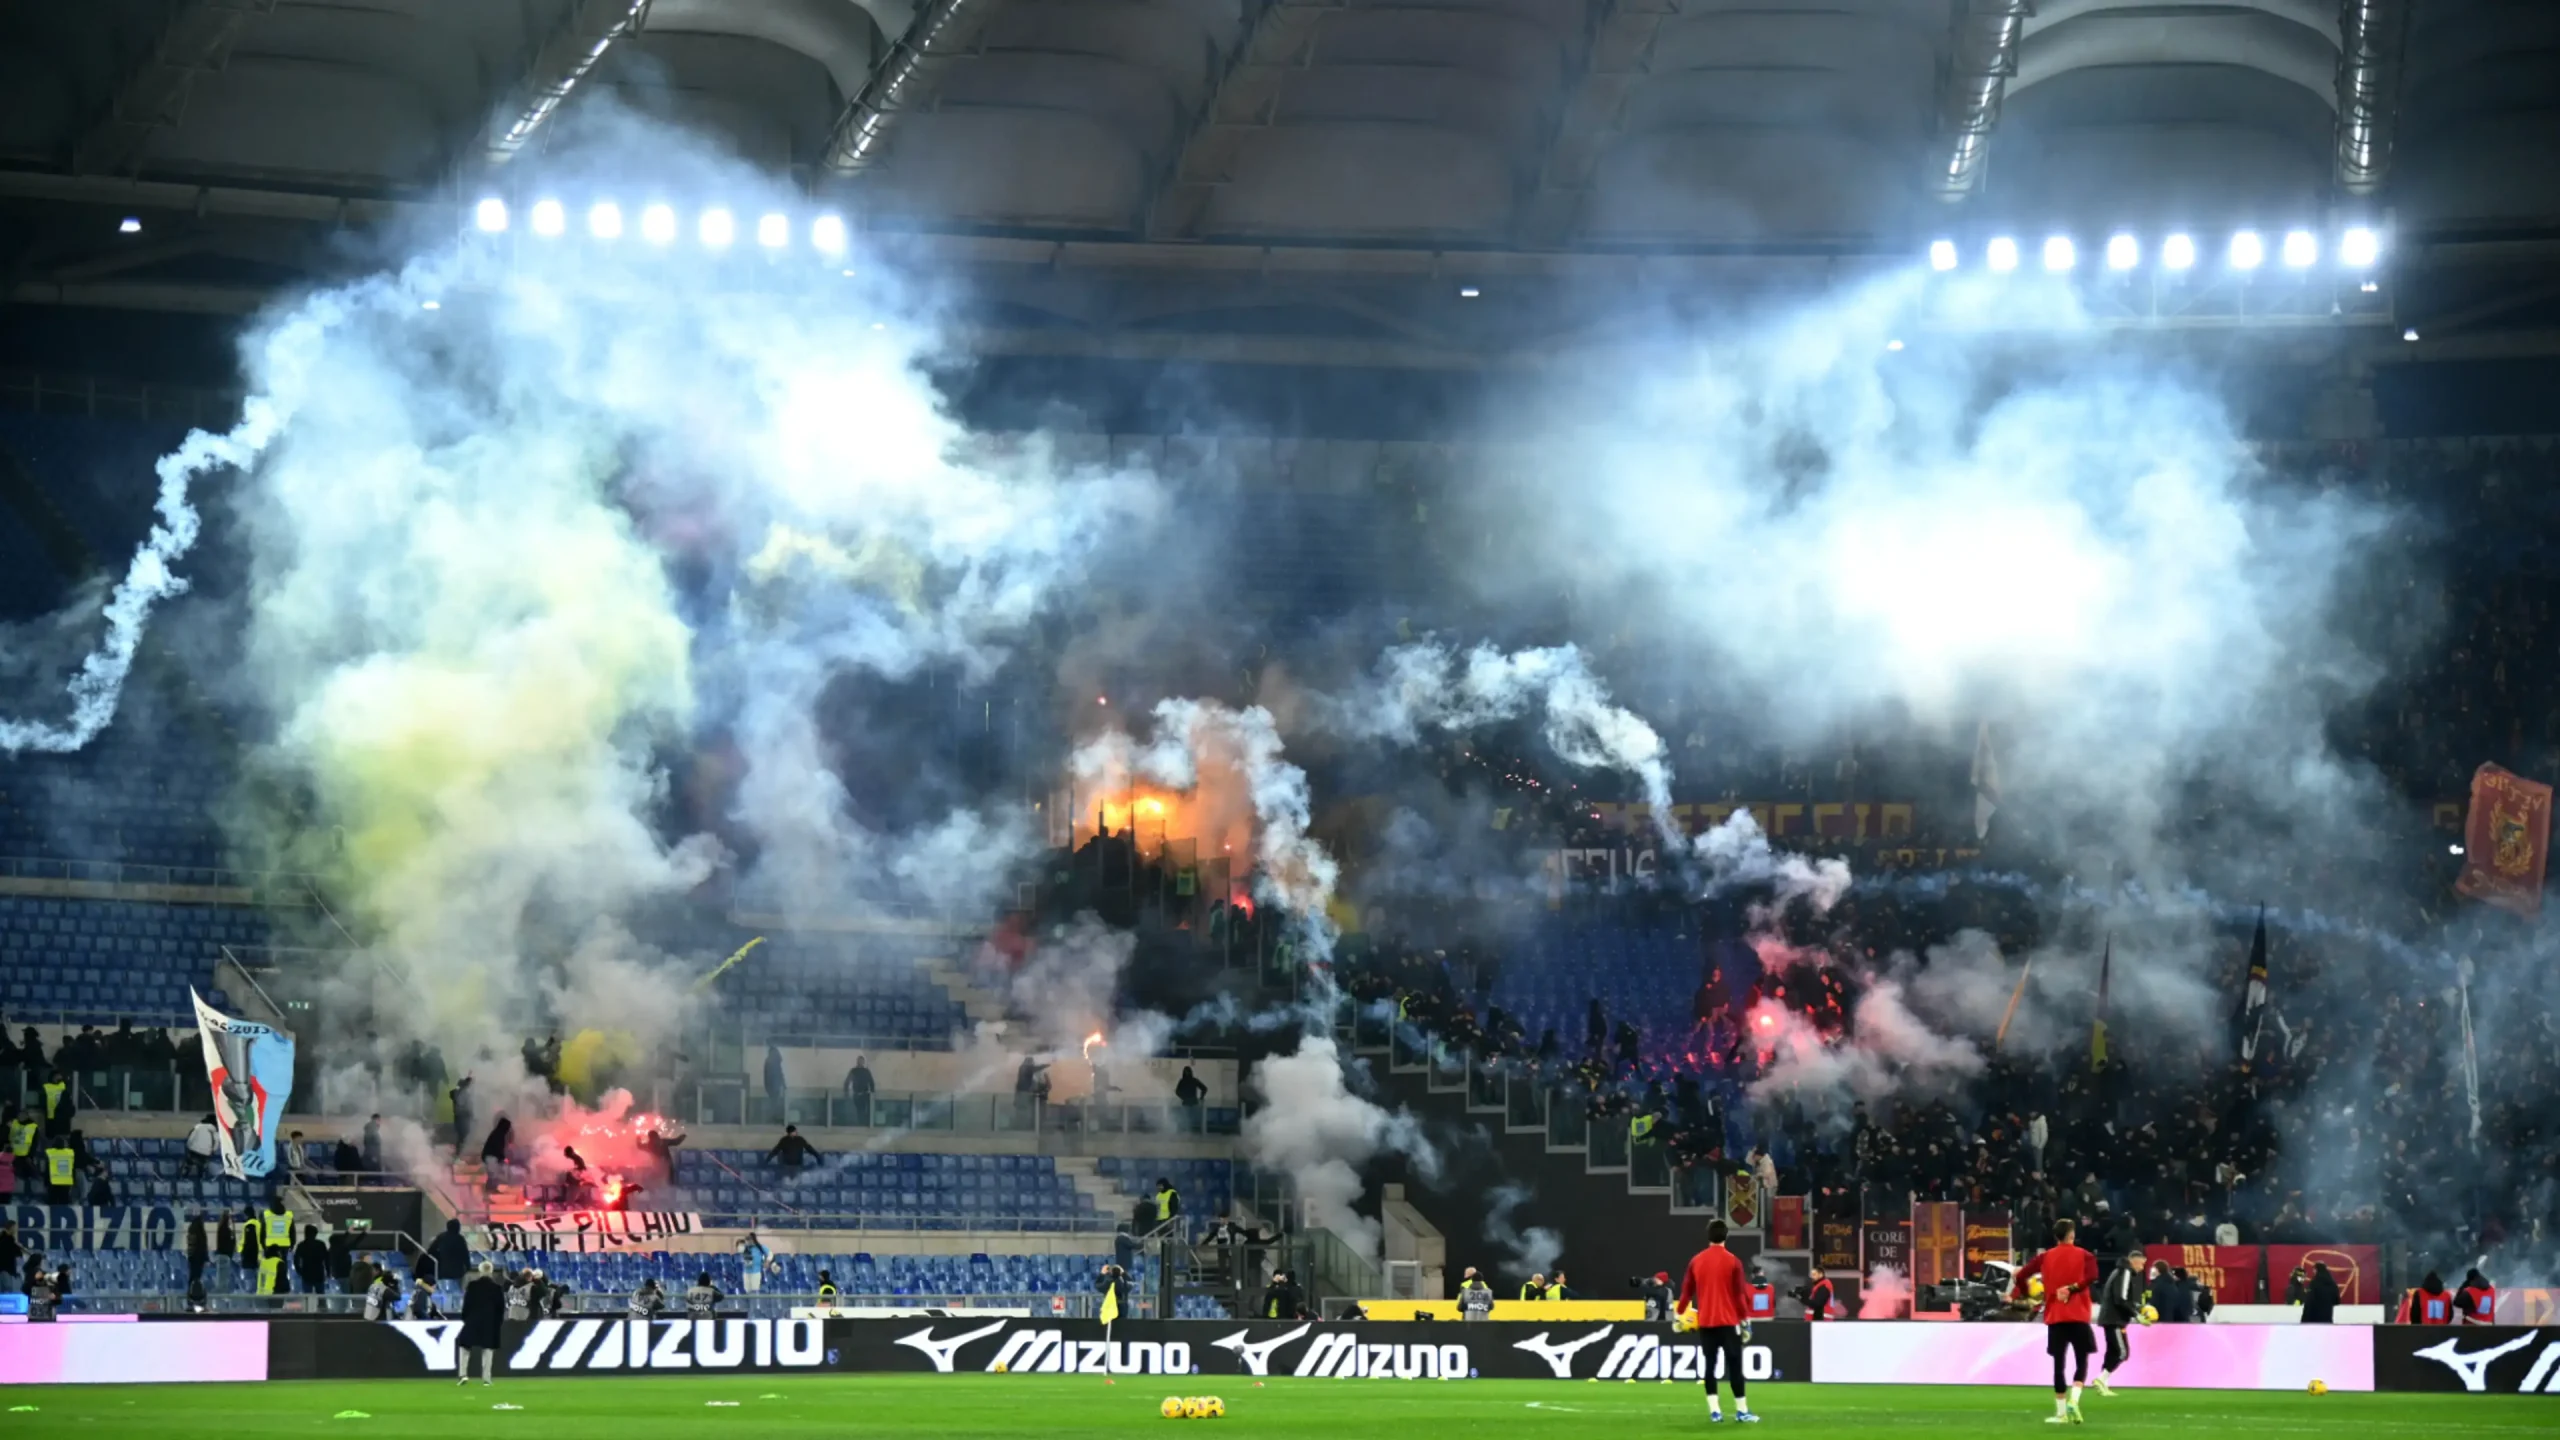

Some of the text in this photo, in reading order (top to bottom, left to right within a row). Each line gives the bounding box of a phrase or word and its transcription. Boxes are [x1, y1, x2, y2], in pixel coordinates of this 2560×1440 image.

[0, 1206, 176, 1251] BRIZIO
[1869, 1231, 1906, 1243] CORE
[1879, 1246, 1898, 1258] DE
[1294, 1333, 1468, 1378] MIZUNO
